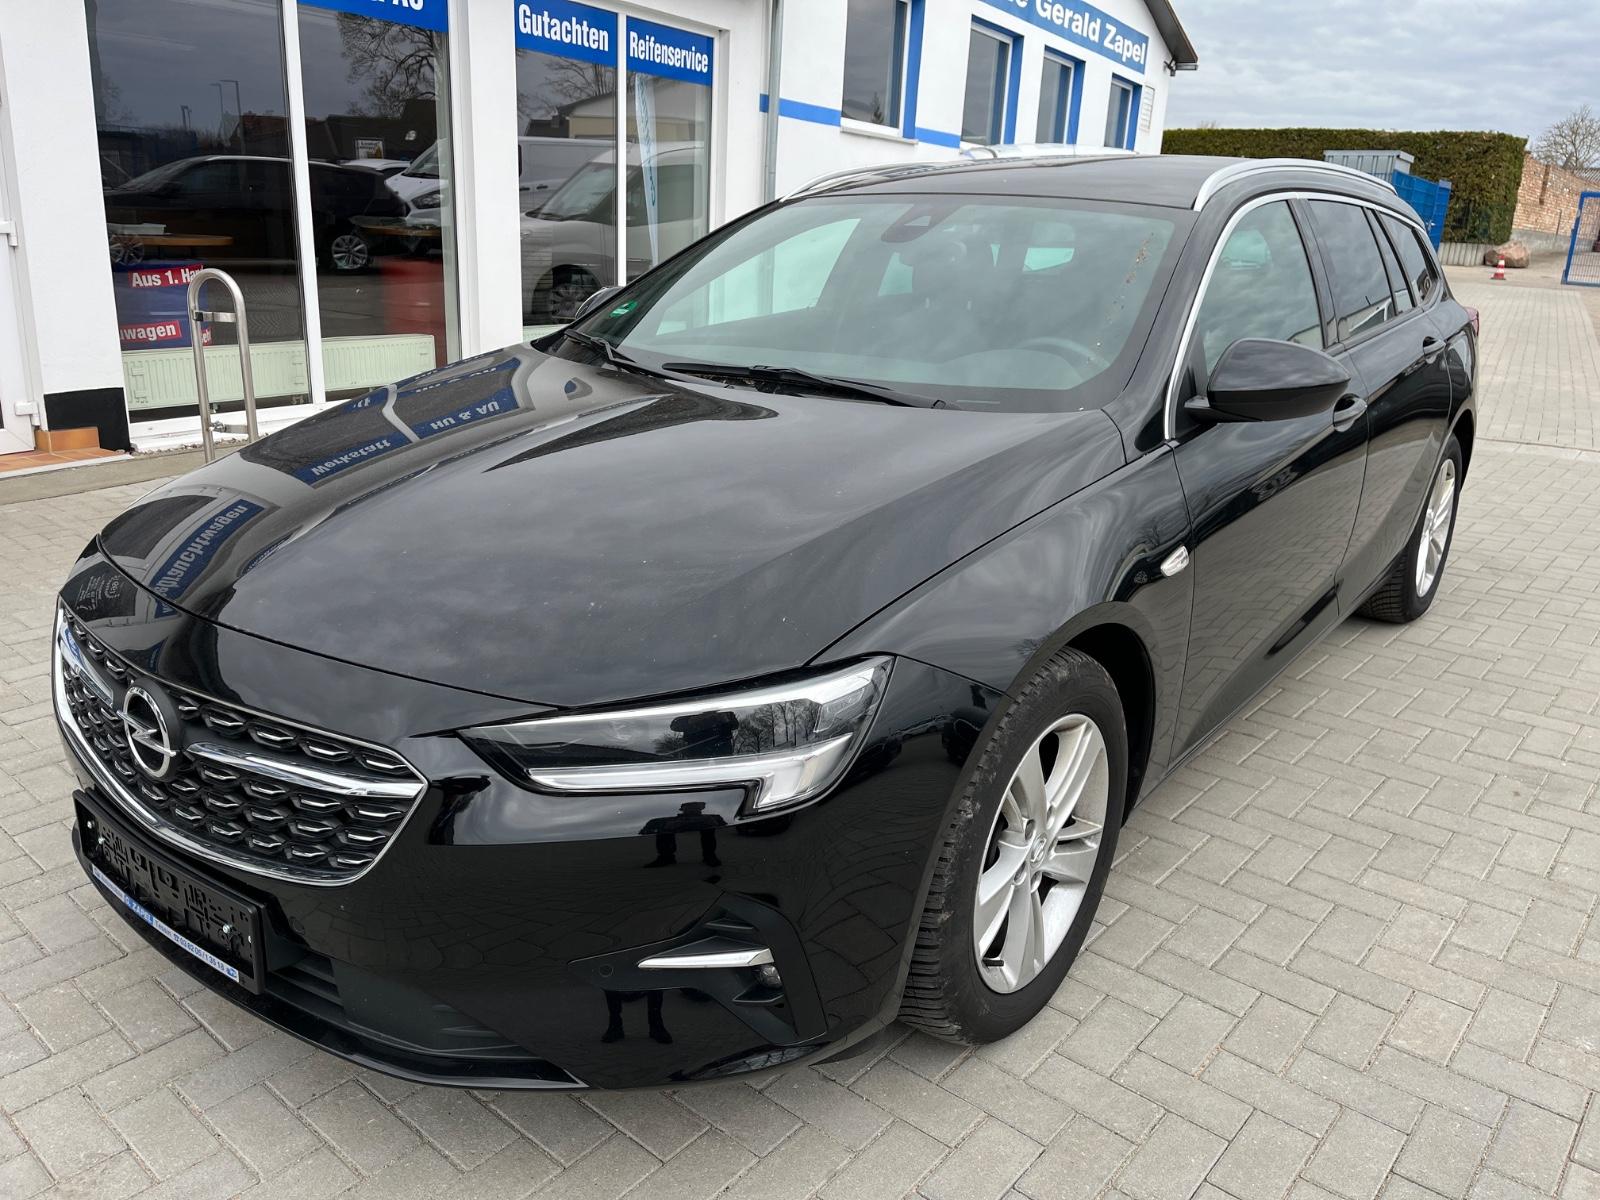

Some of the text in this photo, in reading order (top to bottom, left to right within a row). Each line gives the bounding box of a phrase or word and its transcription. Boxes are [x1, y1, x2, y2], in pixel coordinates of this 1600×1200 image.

[518, 3, 609, 52] Gutachten
[1035, 0, 1147, 64] Gerald Zapel
[629, 31, 709, 73] Reifenservice
[132, 273, 161, 287] Aus
[164, 270, 179, 285] 1.
